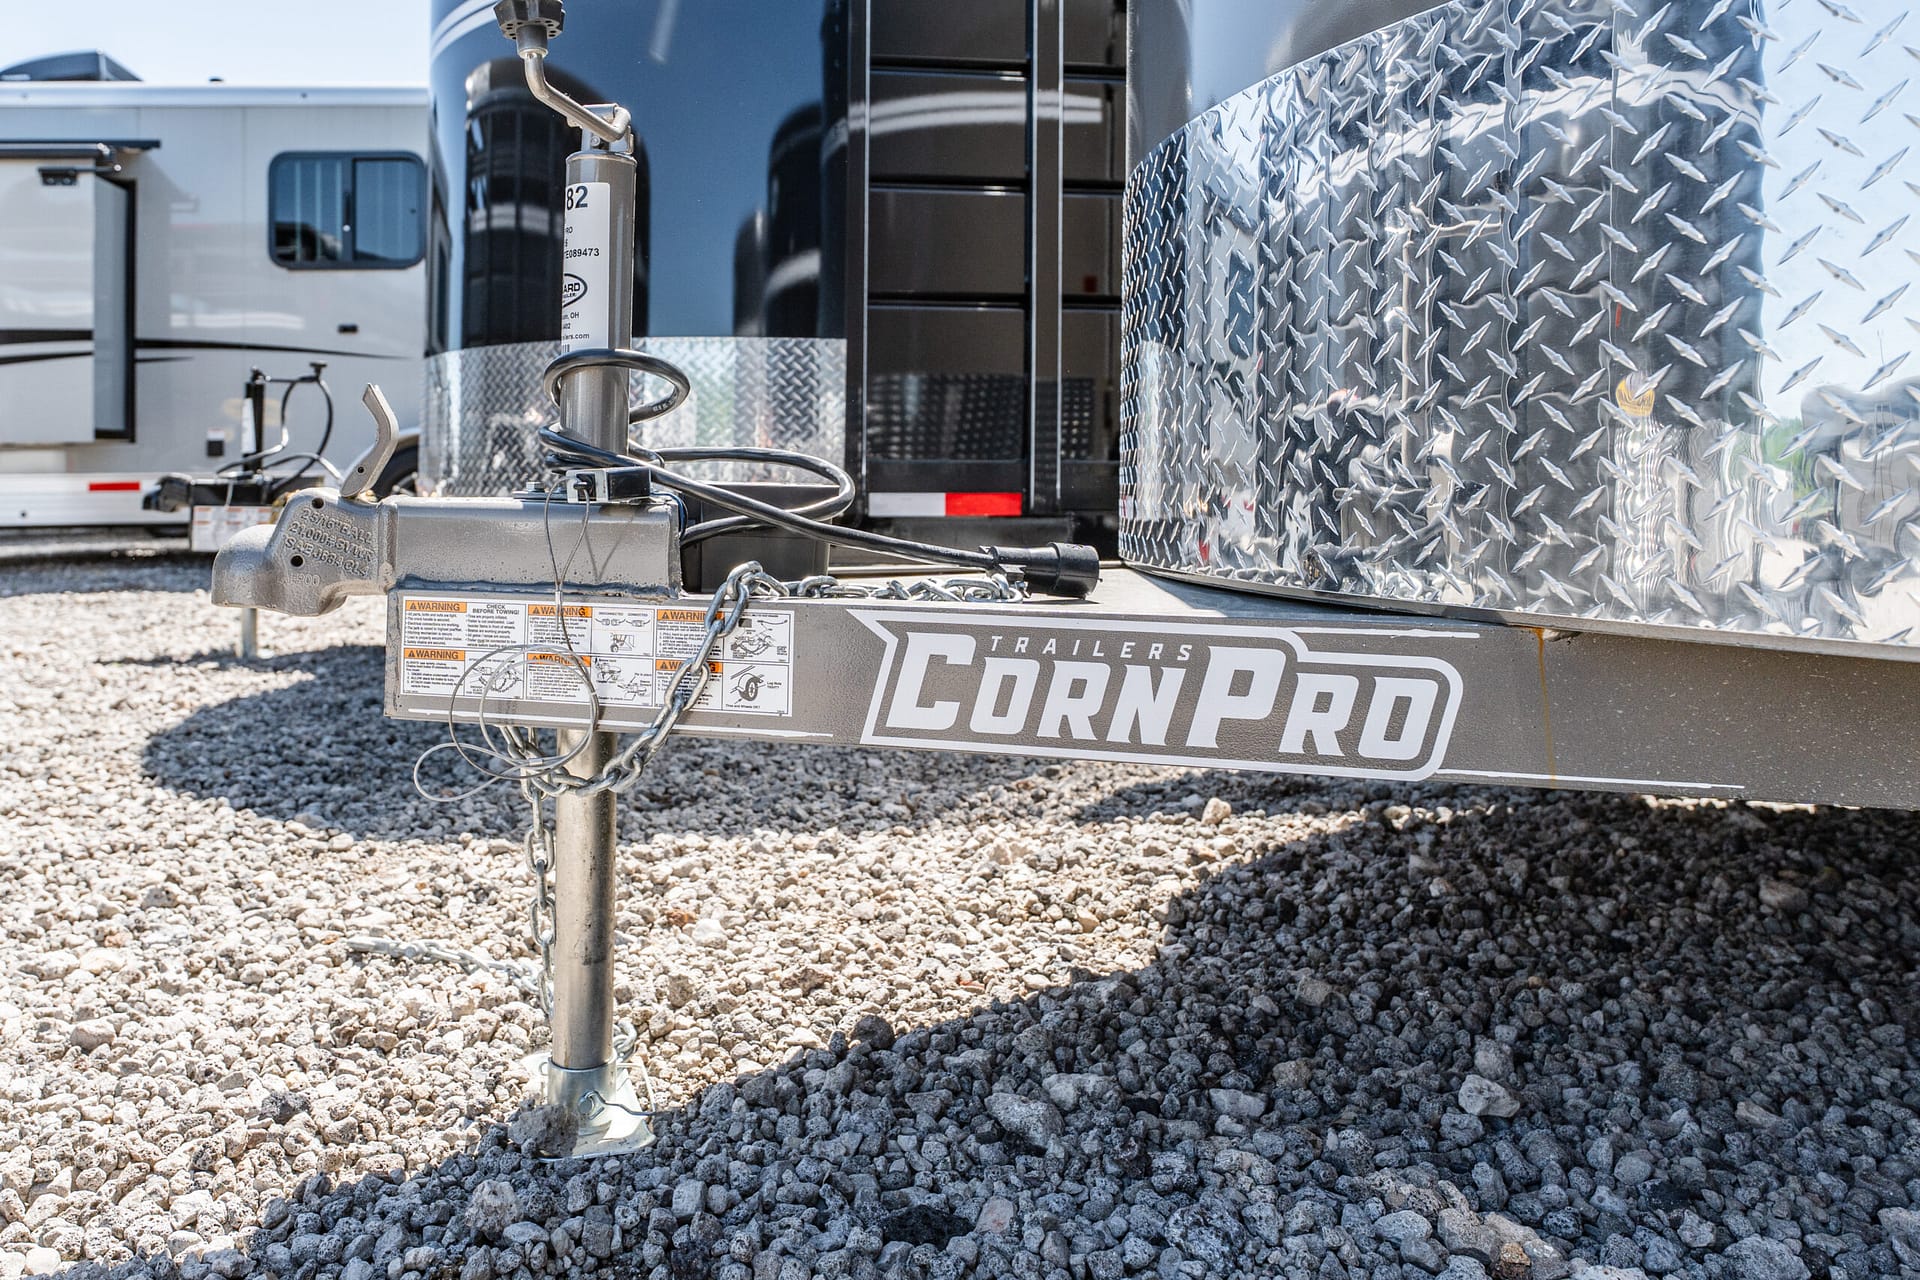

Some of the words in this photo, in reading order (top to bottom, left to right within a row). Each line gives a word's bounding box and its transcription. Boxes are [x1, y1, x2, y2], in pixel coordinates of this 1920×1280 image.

[566, 186, 588, 210] 82
[418, 602, 460, 611] WARNING
[541, 607, 586, 616] WANING
[671, 611, 706, 620] WARNI
[991, 634, 1192, 662] TRAILERS
[416, 650, 459, 659] WARNING
